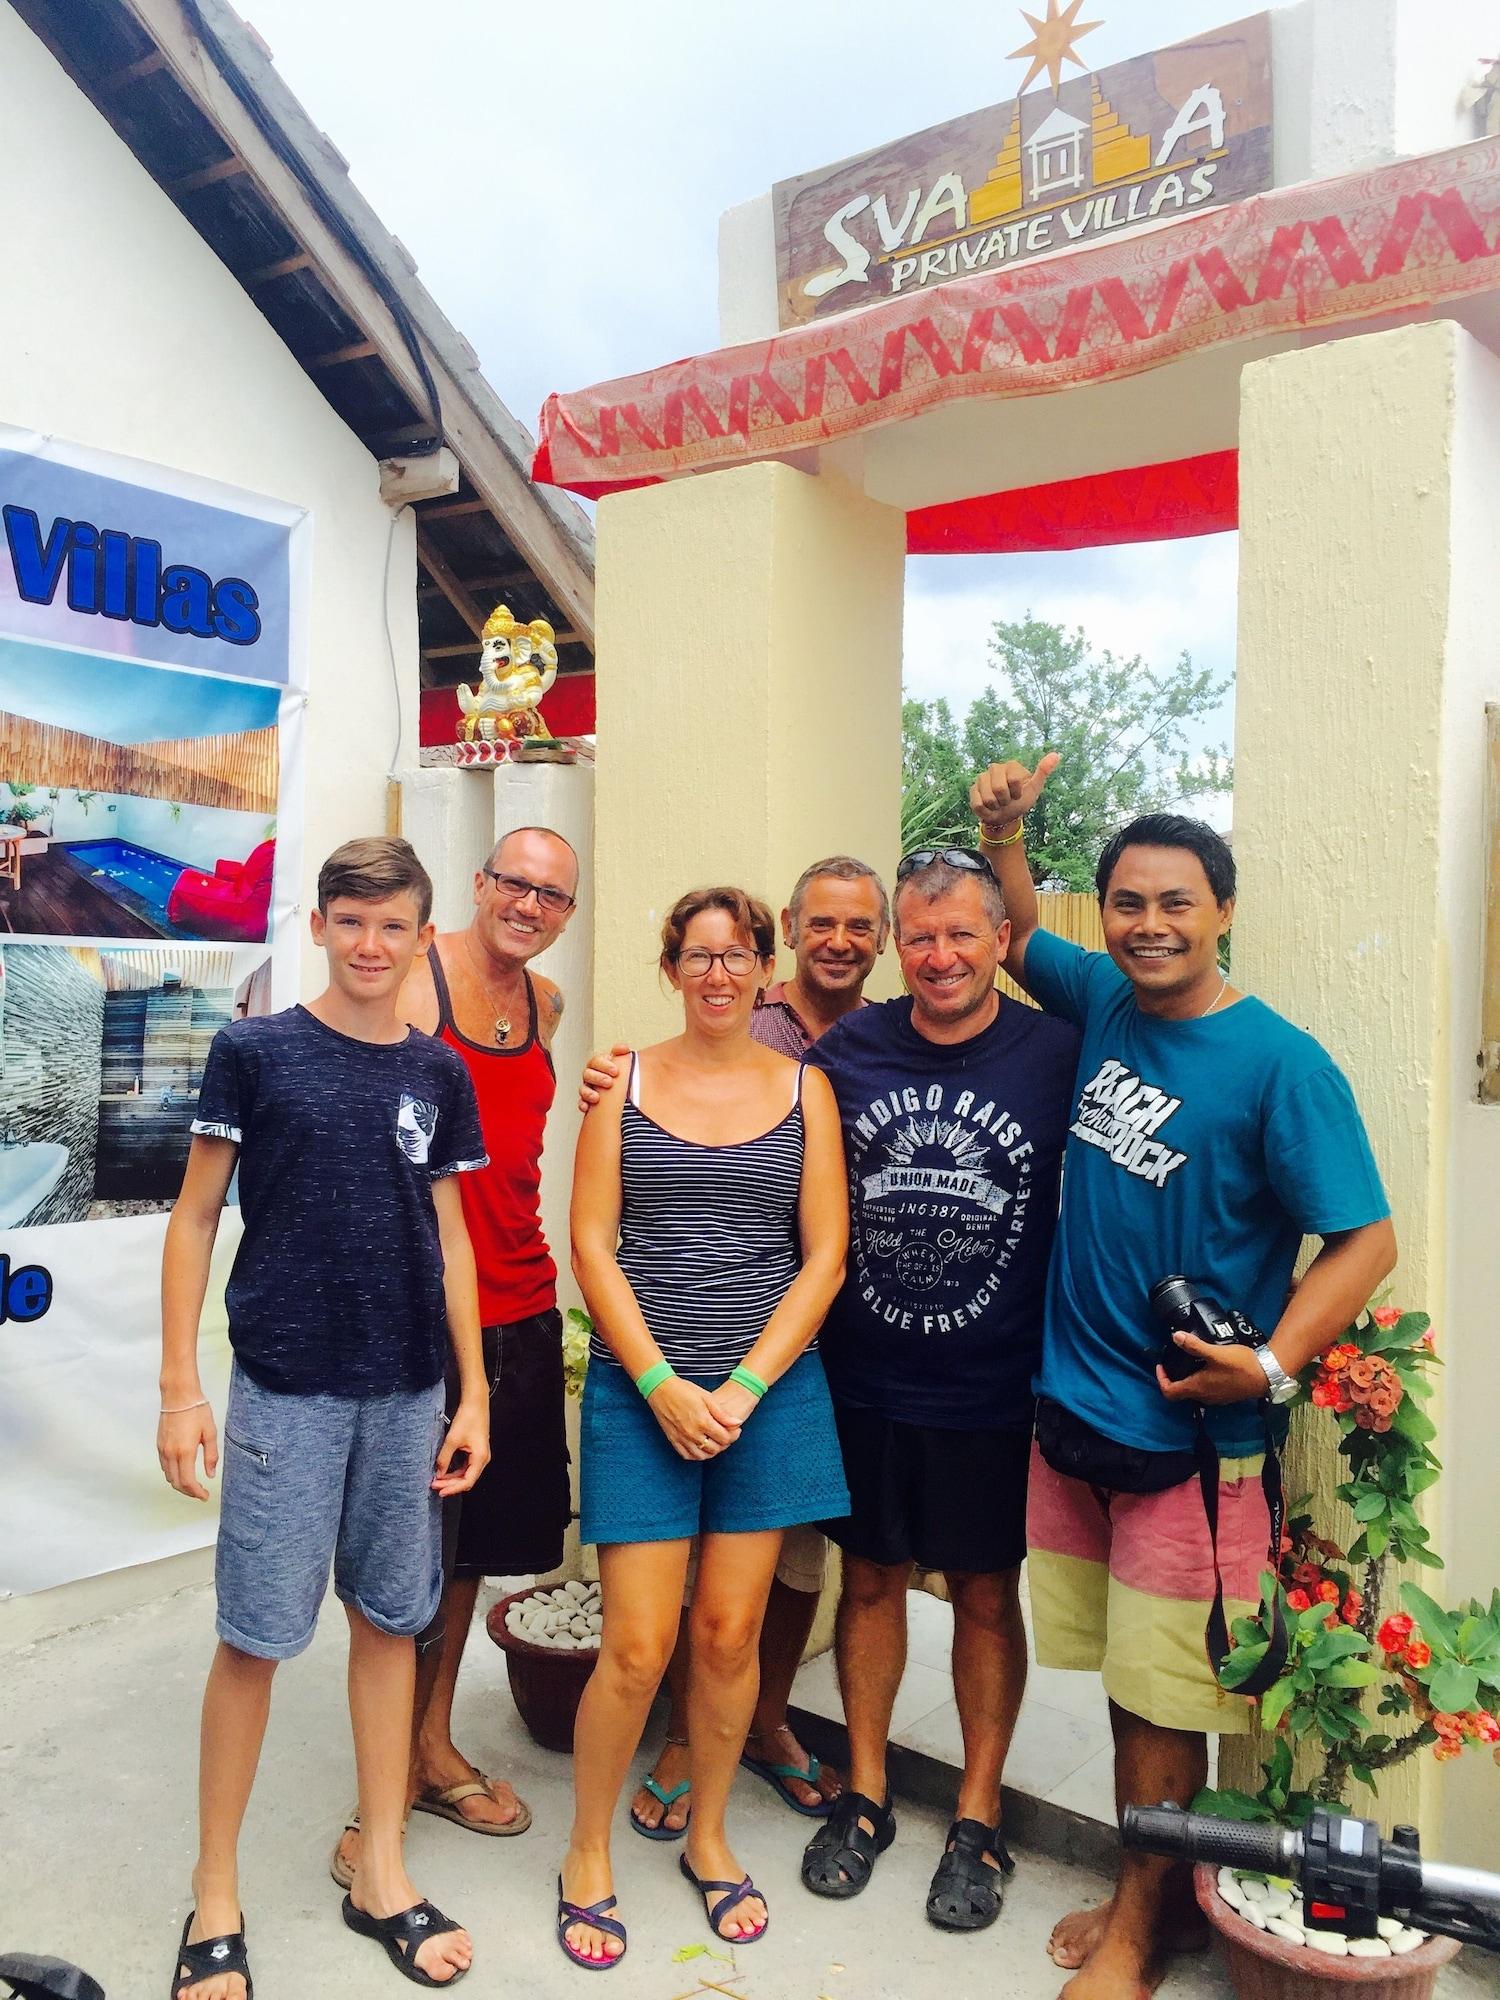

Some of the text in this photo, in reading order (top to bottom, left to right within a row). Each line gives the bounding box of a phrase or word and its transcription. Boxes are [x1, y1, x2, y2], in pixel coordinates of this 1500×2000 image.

[891, 214, 1054, 293] PRIVATE
[1060, 163, 1218, 240] VILLAS
[2, 504, 262, 645] Villas
[850, 1083, 1035, 1166] INDIGO RAISE
[1109, 1119, 1187, 1187] ROCK
[890, 1172, 979, 1196] UNION MADE
[960, 1213, 998, 1222] ORIGINAL
[965, 1222, 991, 1231] DENIM
[909, 1227, 928, 1237] THE
[901, 1248, 937, 1263] WHEN
[901, 1271, 934, 1285] CALM
[862, 1284, 914, 1331] BLUE
[923, 1272, 1001, 1335] FRENCH
